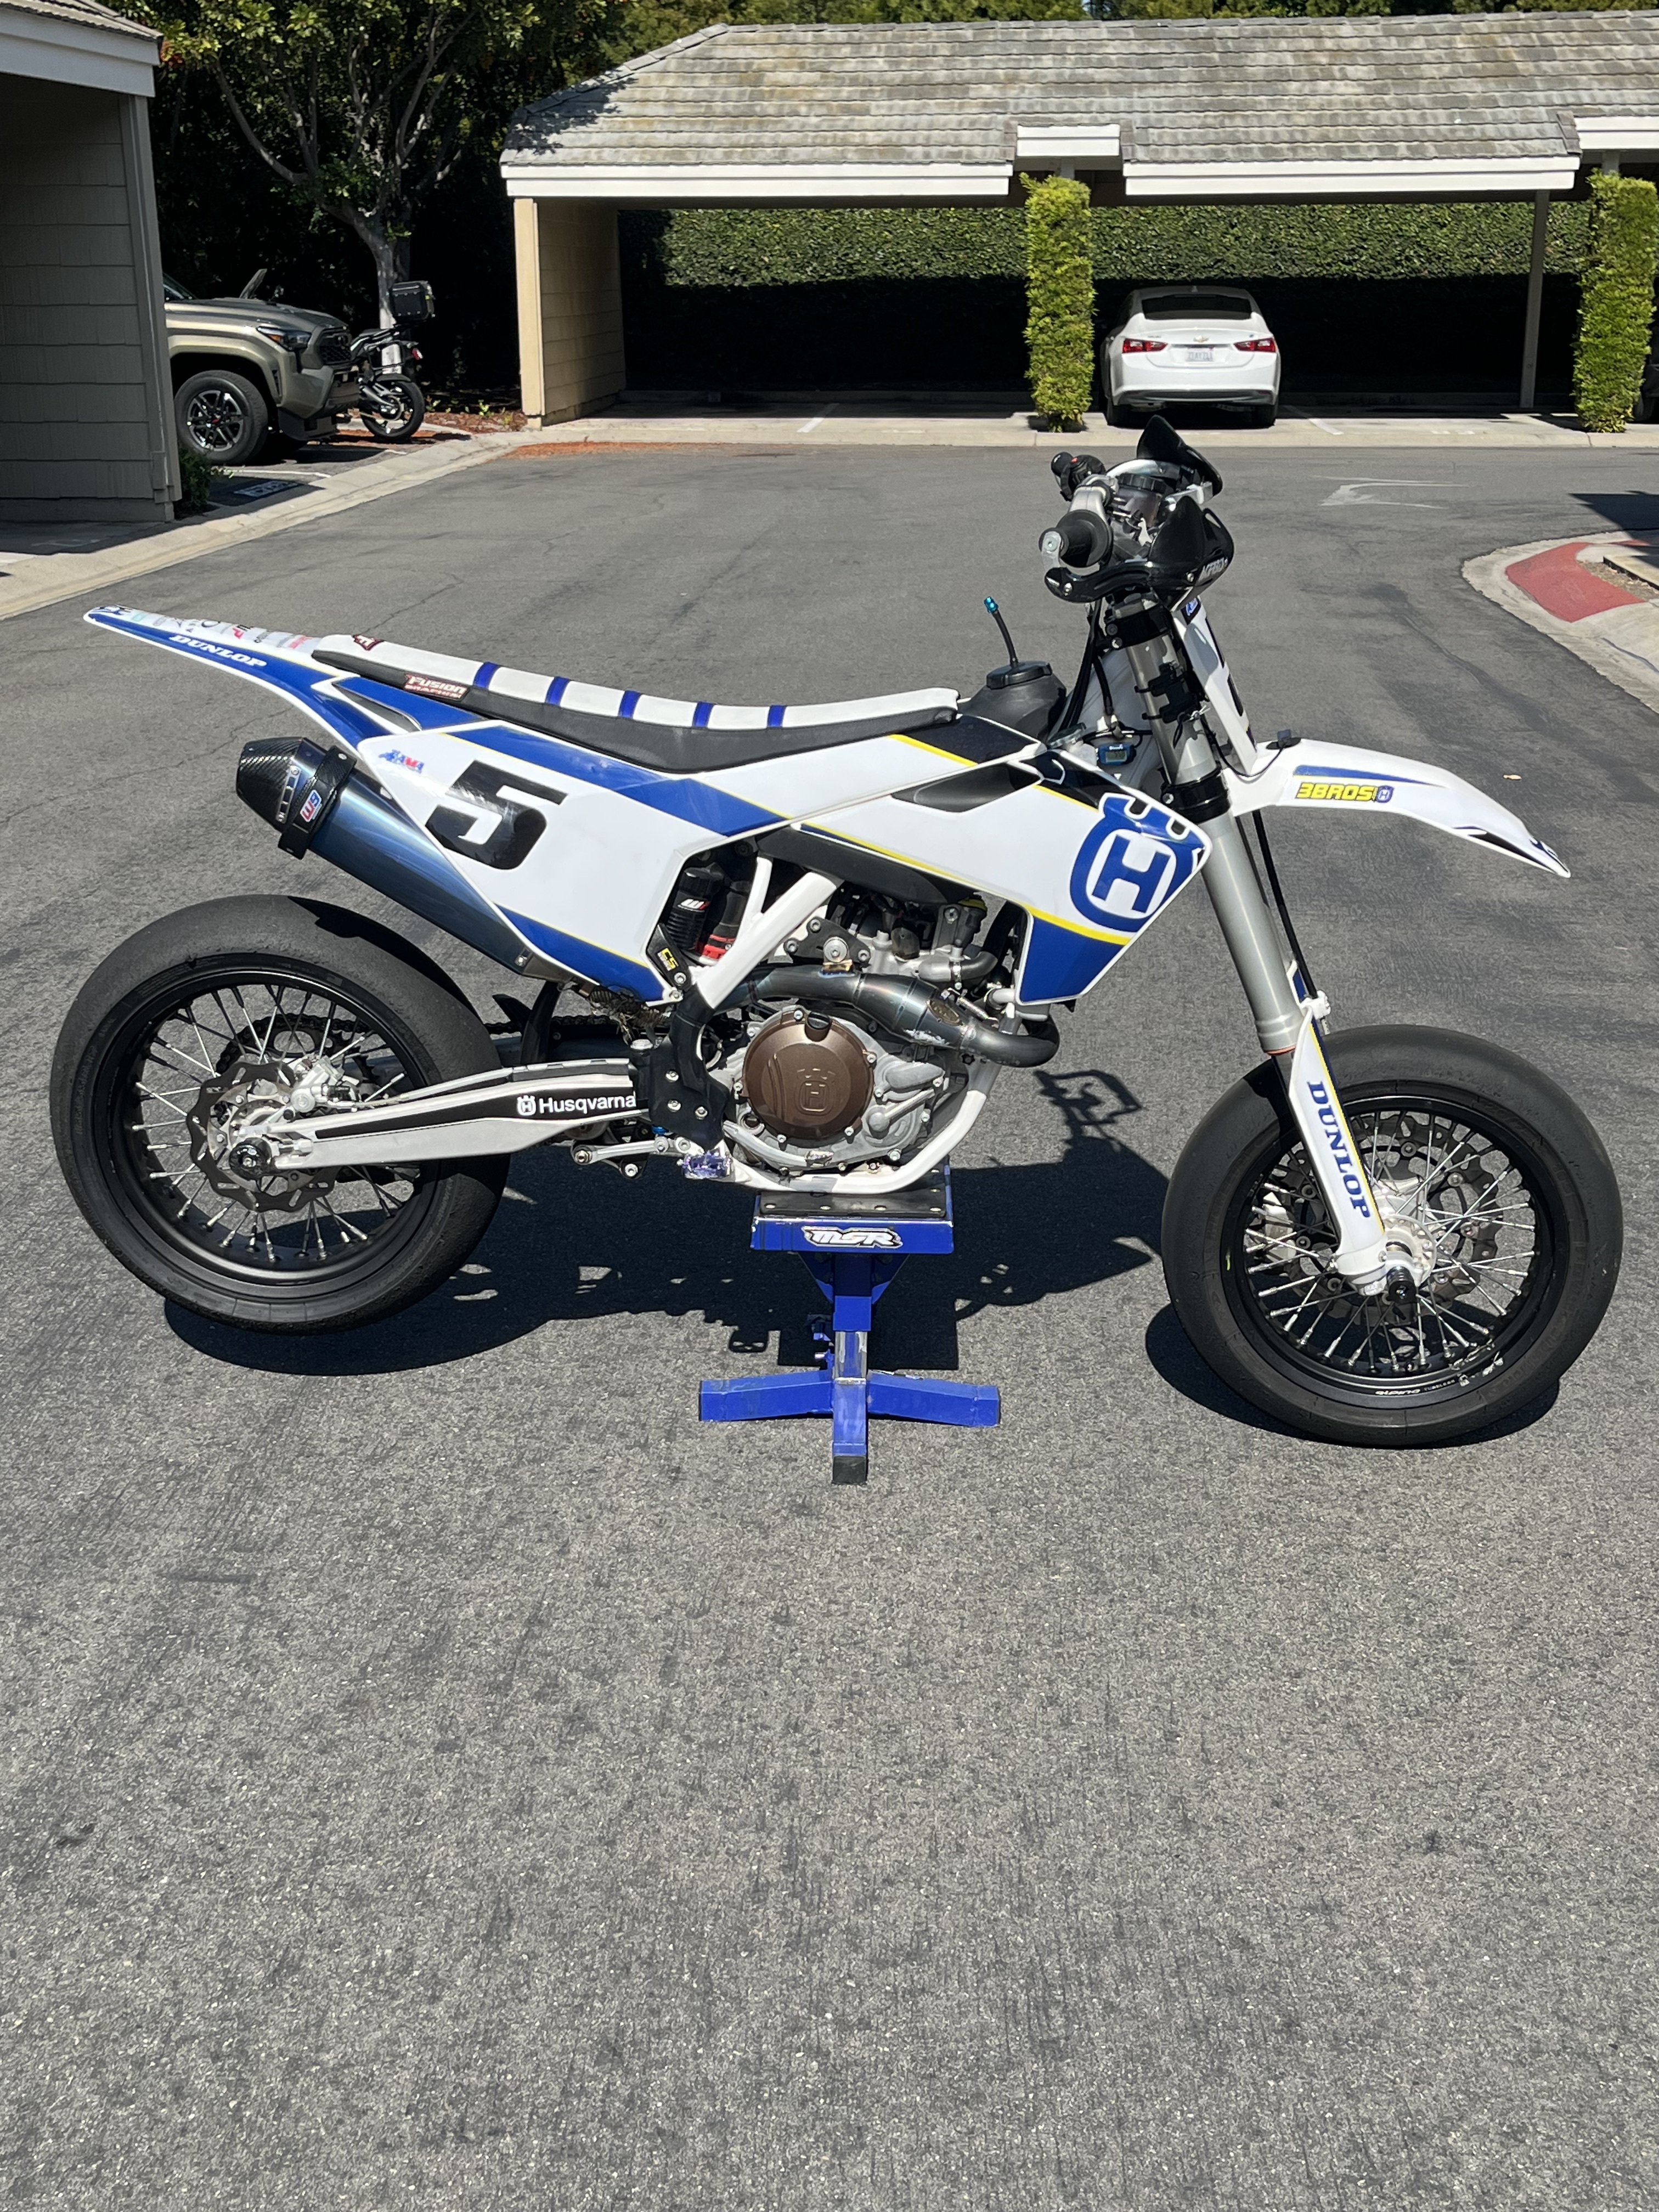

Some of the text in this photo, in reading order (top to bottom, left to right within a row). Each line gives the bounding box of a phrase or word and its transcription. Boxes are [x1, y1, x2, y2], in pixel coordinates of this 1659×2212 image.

[169, 635, 267, 667] DUNLOP
[1296, 783, 1375, 802] 3BROS
[425, 759, 568, 870] 5
[539, 1095, 636, 1114] Husqvarna
[1307, 1080, 1371, 1218] DUNLOP
[810, 1230, 895, 1246] MSR
